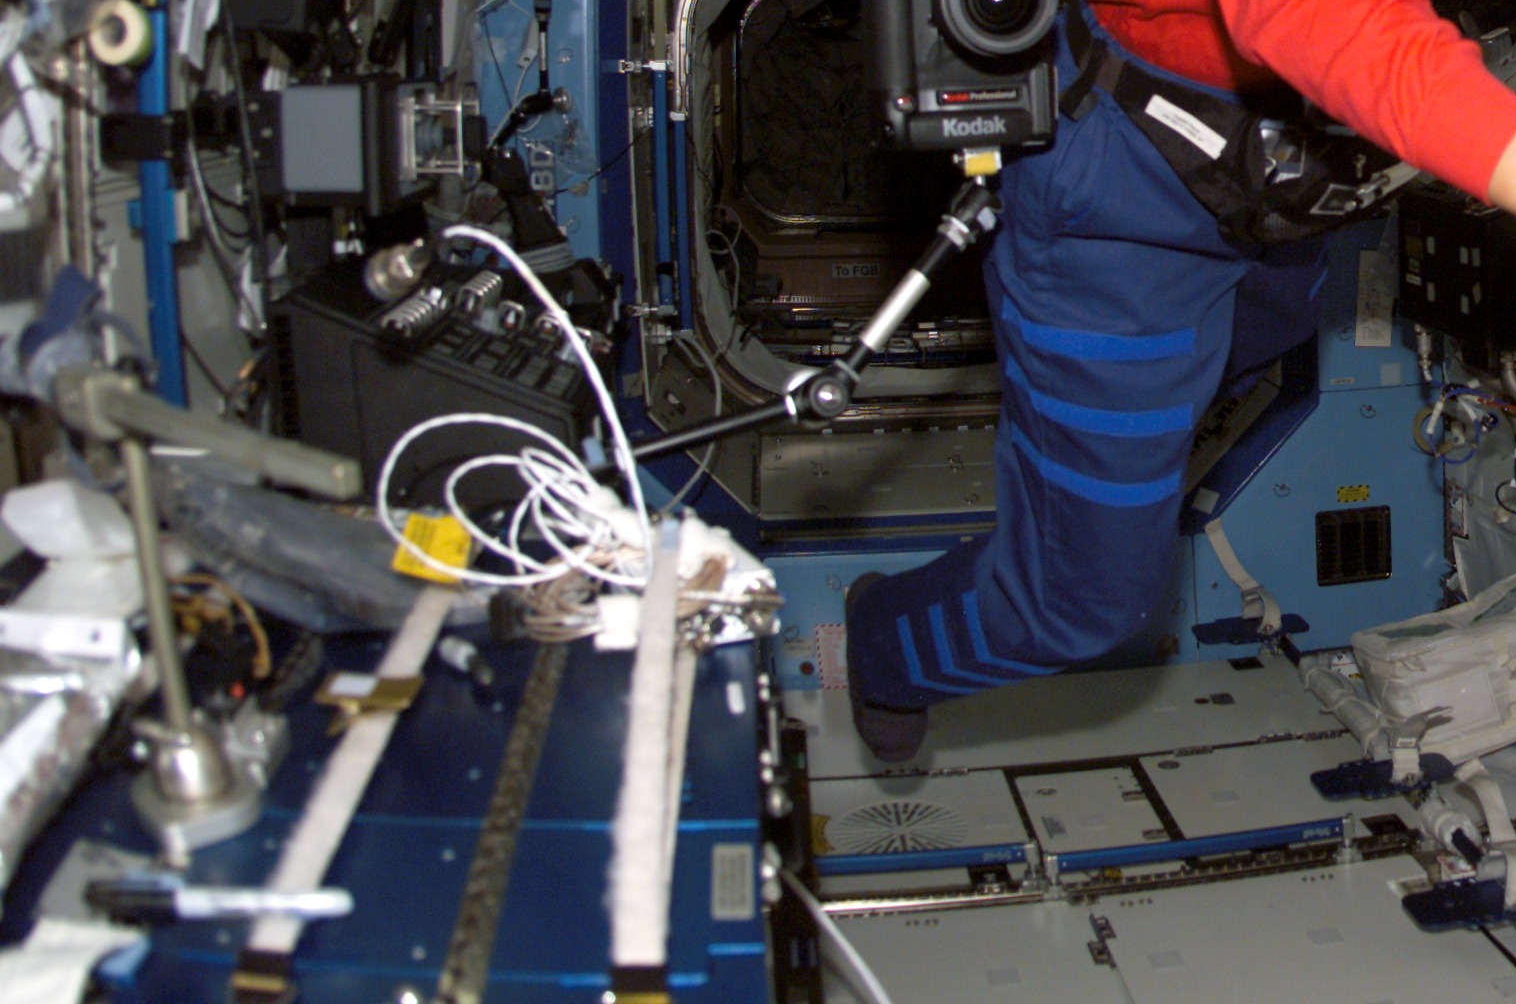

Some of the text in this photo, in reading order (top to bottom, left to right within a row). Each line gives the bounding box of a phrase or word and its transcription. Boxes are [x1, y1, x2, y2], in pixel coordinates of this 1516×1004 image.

[942, 115, 1007, 138] Kodak
[835, 265, 879, 277] To FGB
